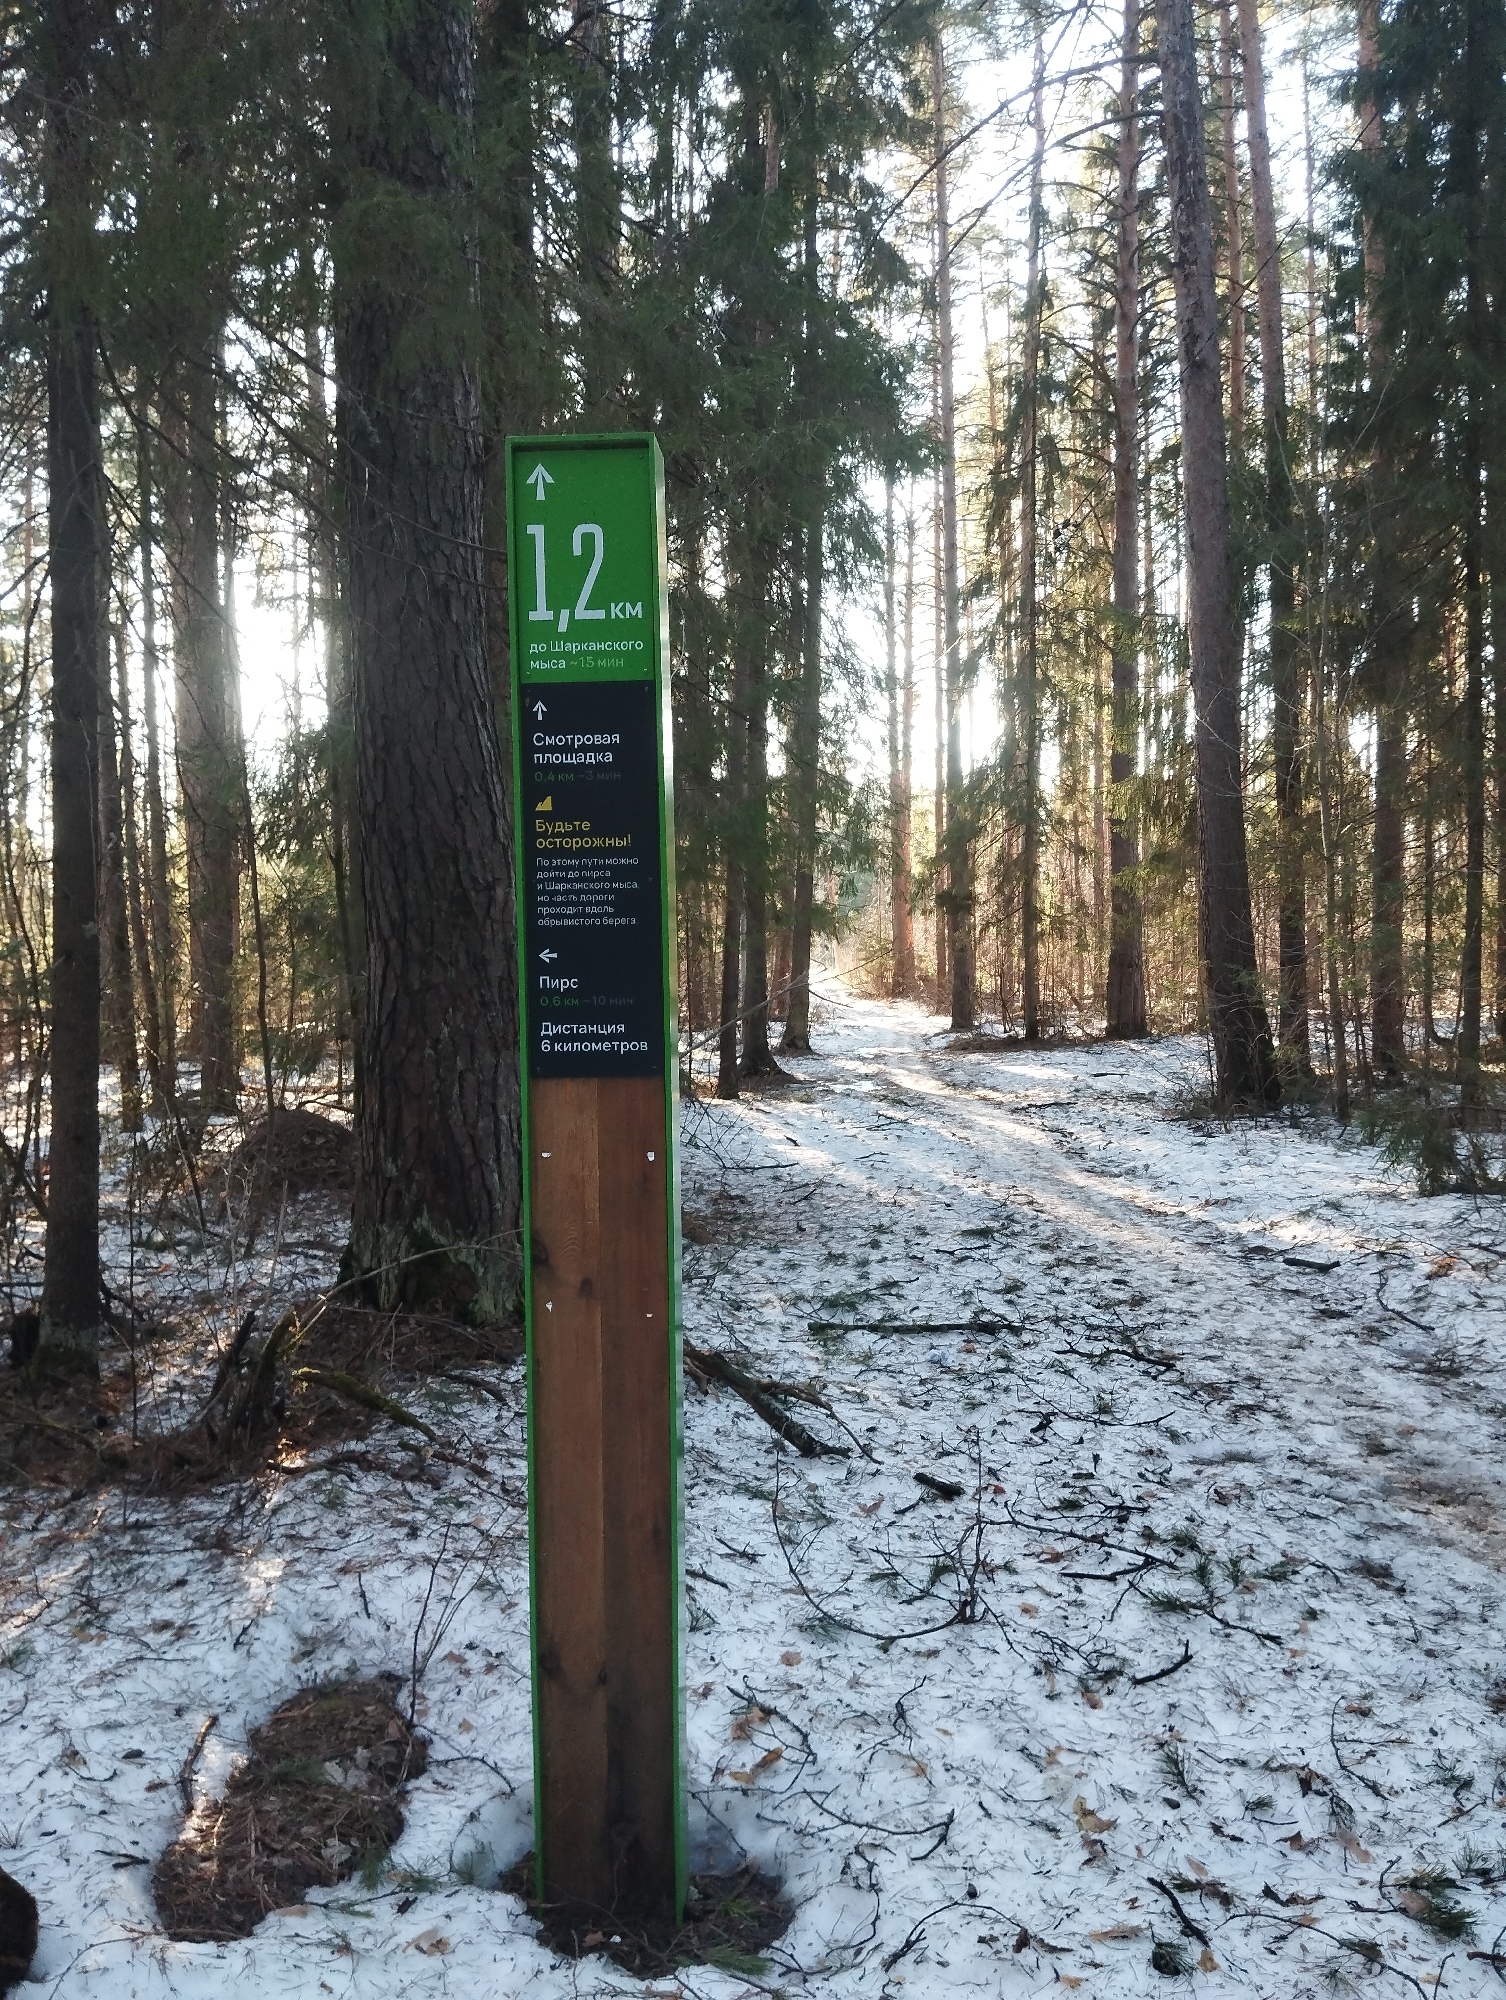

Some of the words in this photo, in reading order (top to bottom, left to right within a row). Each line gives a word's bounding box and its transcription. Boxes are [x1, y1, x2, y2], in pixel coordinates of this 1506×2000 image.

[527, 523, 605, 633] 1,2
[530, 642, 547, 654] до
[550, 639, 644, 655] Шарканского
[530, 658, 566, 669] мыса
[598, 658, 624, 668] мин
[533, 733, 620, 748] Смотровая
[534, 752, 613, 765] площадка
[558, 772, 574, 781] км
[597, 771, 621, 780] мин
[536, 820, 591, 835] Будьте
[536, 834, 632, 851] осторожны!
[537, 858, 549, 867] По
[552, 858, 580, 868] этому
[581, 858, 604, 867] пути
[606, 857, 639, 865] можно
[537, 870, 566, 878] дойти
[581, 870, 611, 879] пирса
[545, 882, 610, 891] Шарканского
[580, 894, 615, 903] дороги
[537, 906, 583, 916] проходит
[585, 905, 614, 914] вдоль
[537, 918, 601, 927] обрывистого
[539, 976, 579, 992] Пирс
[564, 996, 579, 1006] км
[609, 997, 633, 1005] мин
[541, 1022, 625, 1036] Дистанция
[541, 1039, 550, 1052] 6
[554, 1041, 648, 1055] километров
